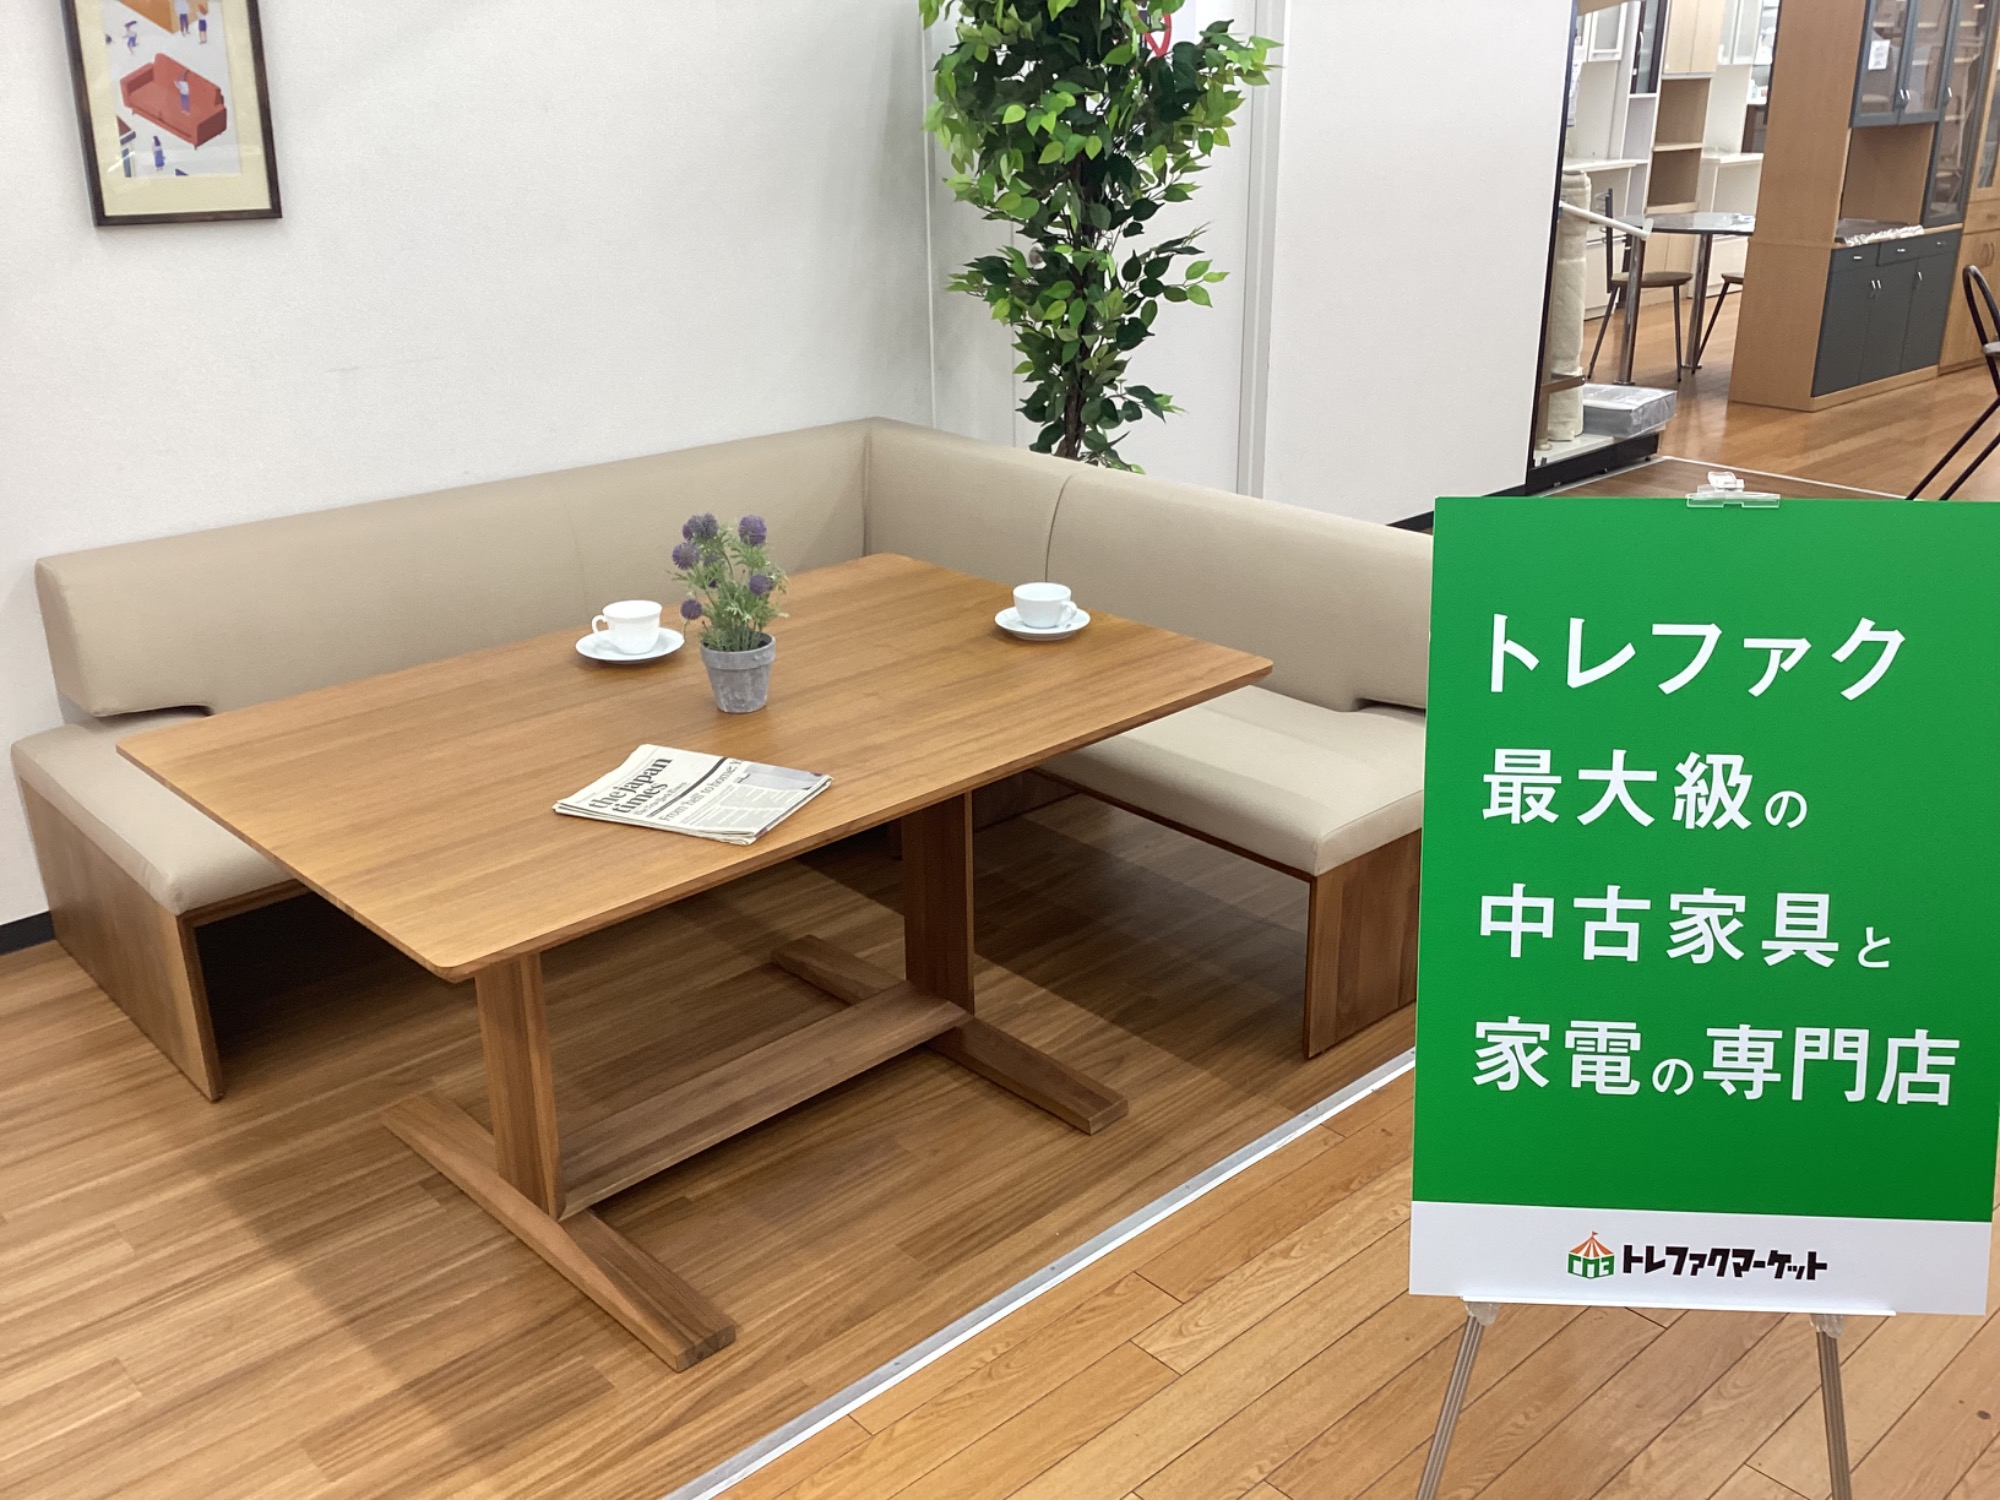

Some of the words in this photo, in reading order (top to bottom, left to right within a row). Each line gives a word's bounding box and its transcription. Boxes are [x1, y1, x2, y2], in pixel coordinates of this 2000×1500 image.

[1490, 613, 1906, 701] トレファク
[589, 791, 627, 808] the
[612, 758, 672, 793] japan
[612, 783, 668, 813] times
[1481, 748, 1808, 830] 最大級の
[1480, 882, 1891, 968] 中古家具と
[1472, 1015, 1960, 1106] 家電の専門店
[1622, 1244, 1828, 1281] トレファクマーケット
